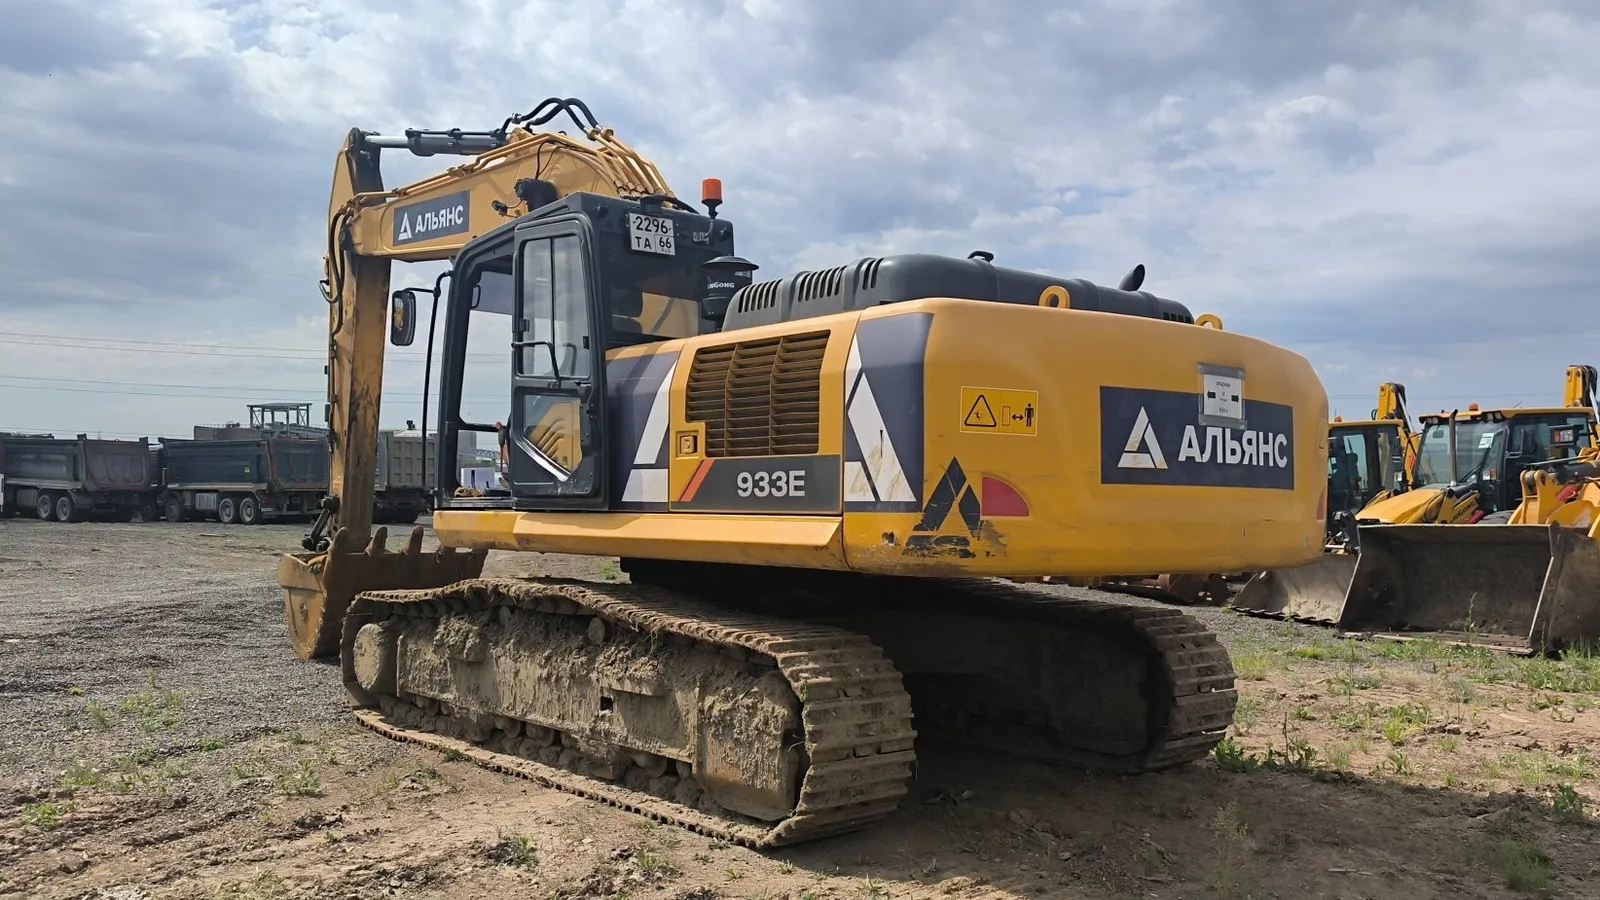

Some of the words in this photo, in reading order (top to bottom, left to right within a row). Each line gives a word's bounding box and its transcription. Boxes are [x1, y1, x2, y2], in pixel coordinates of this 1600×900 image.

[415, 204, 463, 233] АЛЬЯНС
[635, 216, 669, 235] 2296
[659, 236, 672, 249] 66
[1178, 424, 1288, 468] АЛЬЯНС
[737, 470, 806, 497] 933E
